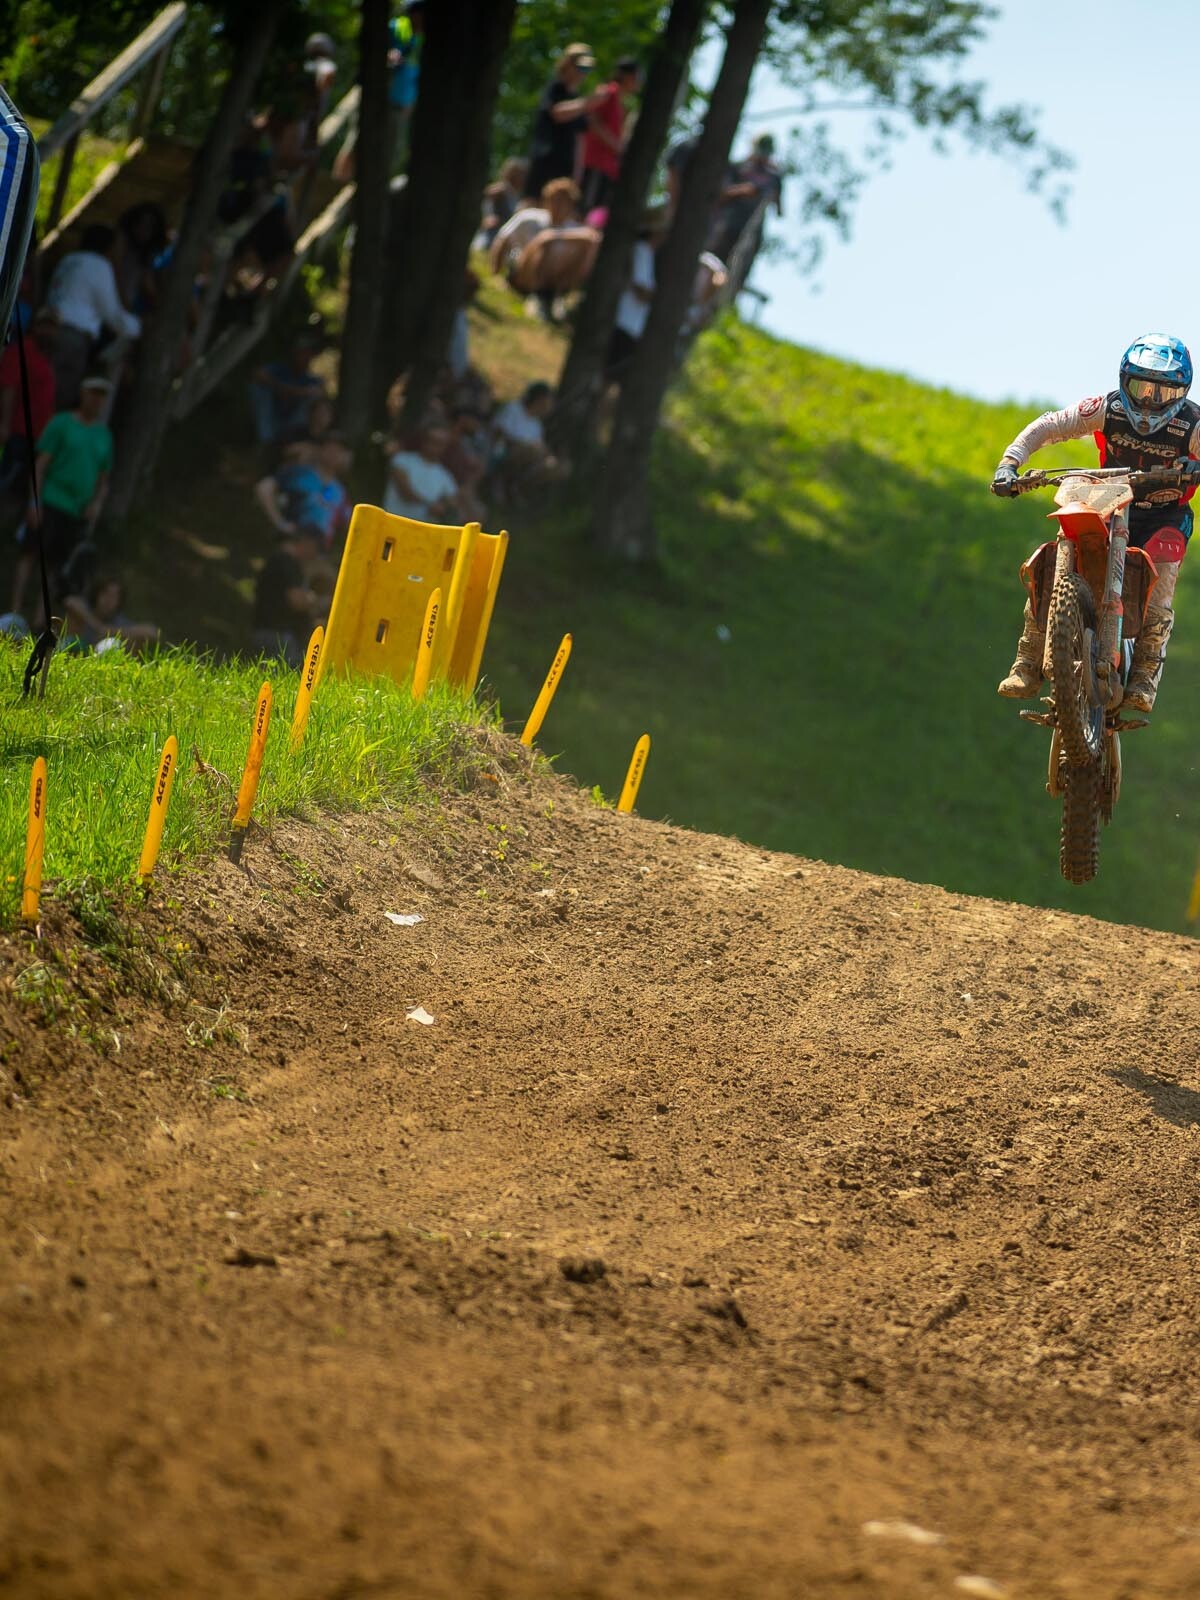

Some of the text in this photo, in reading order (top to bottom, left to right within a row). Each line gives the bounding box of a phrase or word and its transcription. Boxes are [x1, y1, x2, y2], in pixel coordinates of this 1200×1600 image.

[426, 604, 439, 649] ACERBIS
[305, 643, 320, 691] ACERBIS
[256, 699, 267, 737] ACERBIS
[155, 753, 172, 806] ACERBIS
